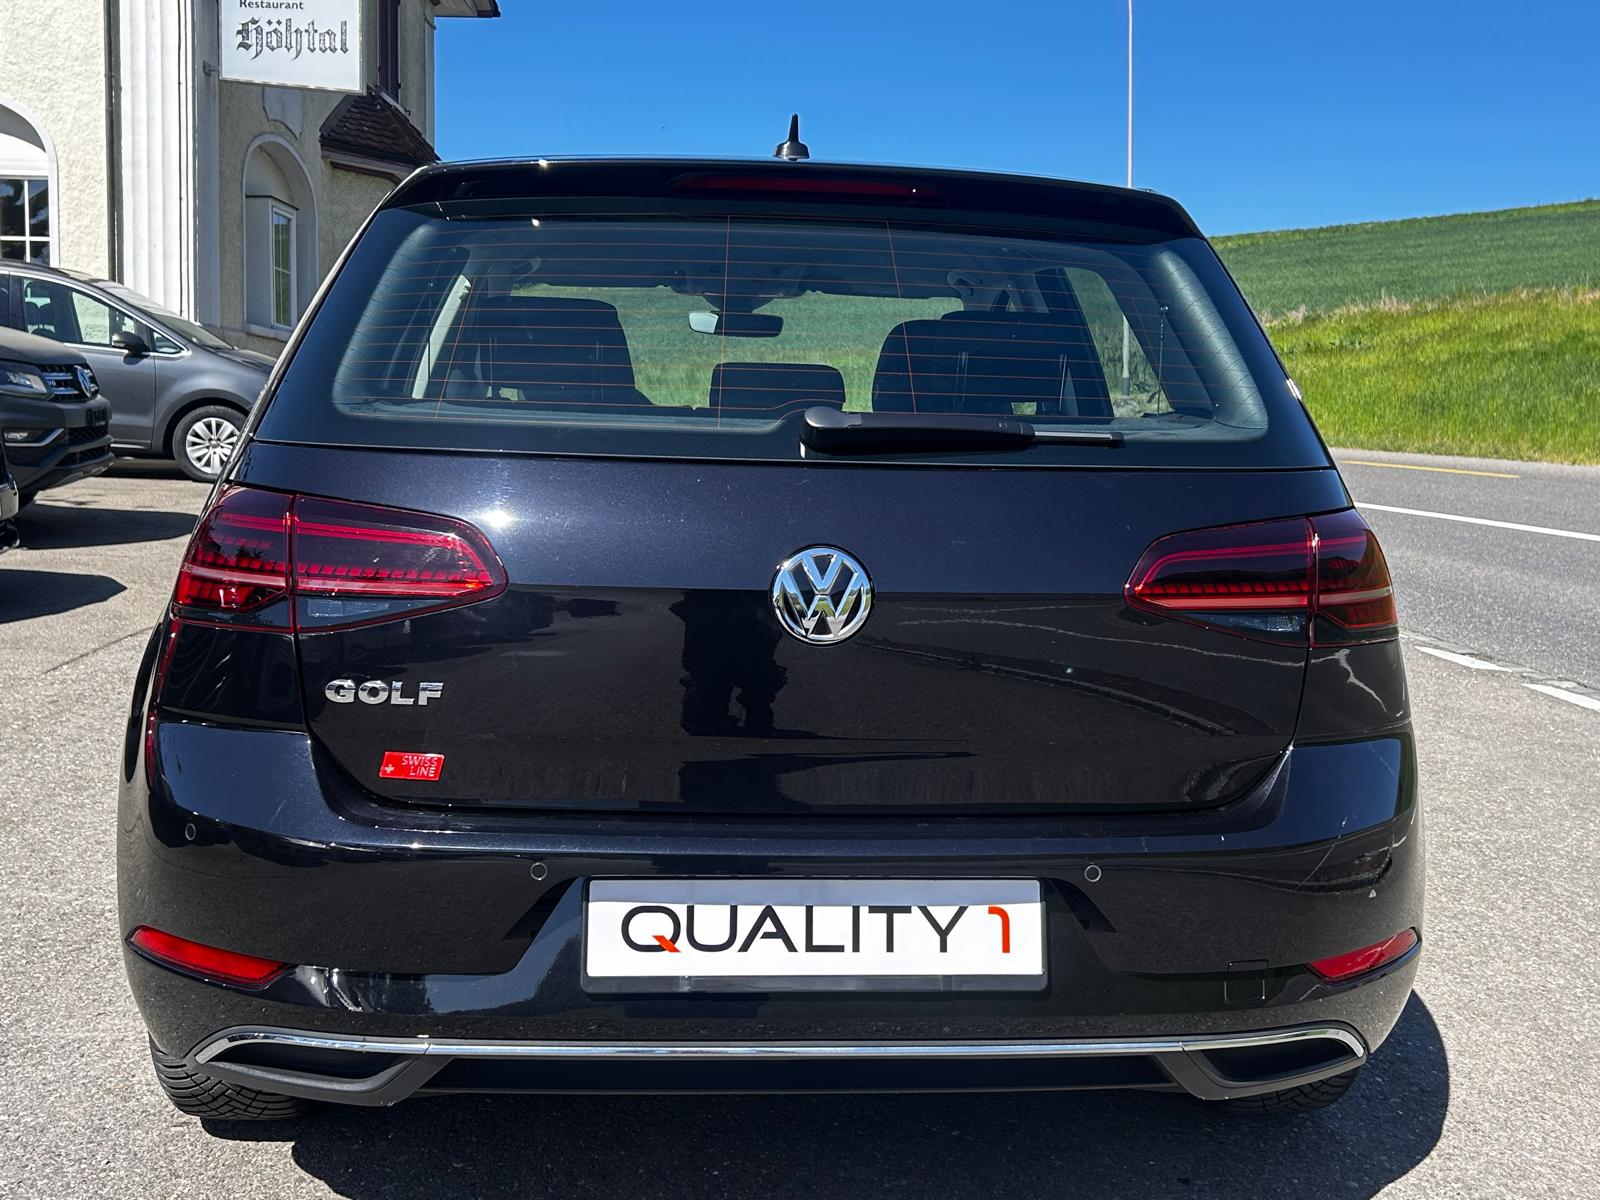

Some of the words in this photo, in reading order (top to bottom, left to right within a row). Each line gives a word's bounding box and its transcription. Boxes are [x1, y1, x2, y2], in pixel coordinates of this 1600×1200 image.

[239, 0, 304, 10] Restaurant
[236, 17, 349, 61] Höhtal
[324, 679, 444, 706] GOLF
[401, 755, 438, 767] SWISS
[409, 765, 436, 777] LINE
